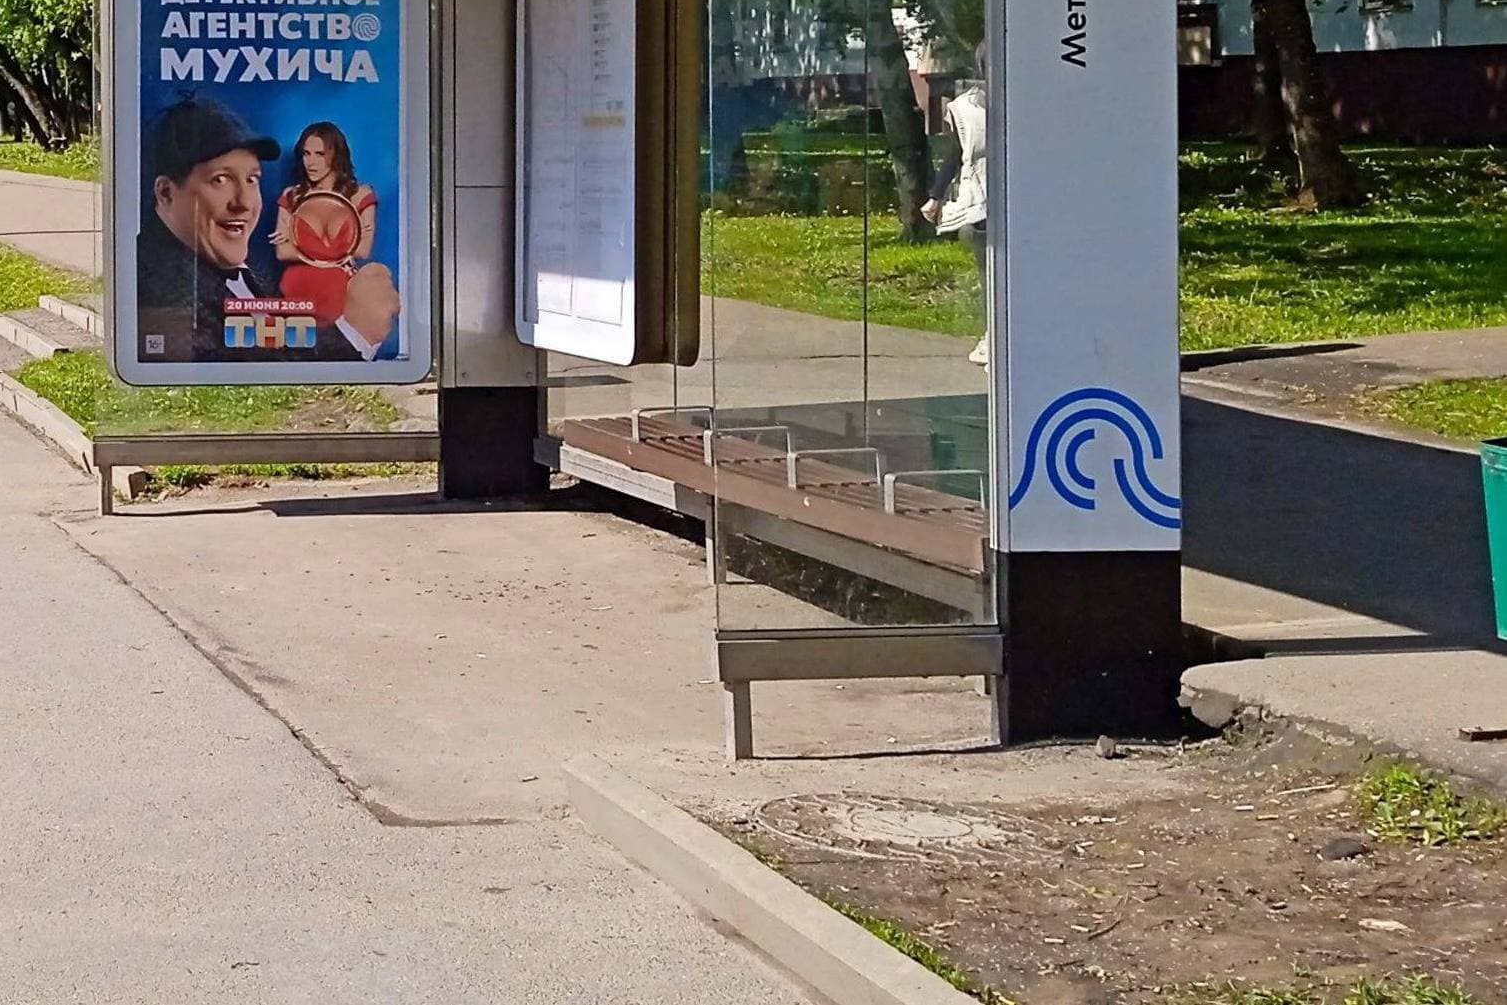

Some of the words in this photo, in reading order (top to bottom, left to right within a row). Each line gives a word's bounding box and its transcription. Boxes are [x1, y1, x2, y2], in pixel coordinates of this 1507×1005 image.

[160, 12, 382, 40] АГЕНТСТВО
[159, 47, 379, 83] МУХИЧА
[227, 300, 243, 311] 20
[244, 300, 280, 311] ИЮНЯ
[281, 300, 314, 311] 20:00
[224, 315, 317, 348] ТНТ
